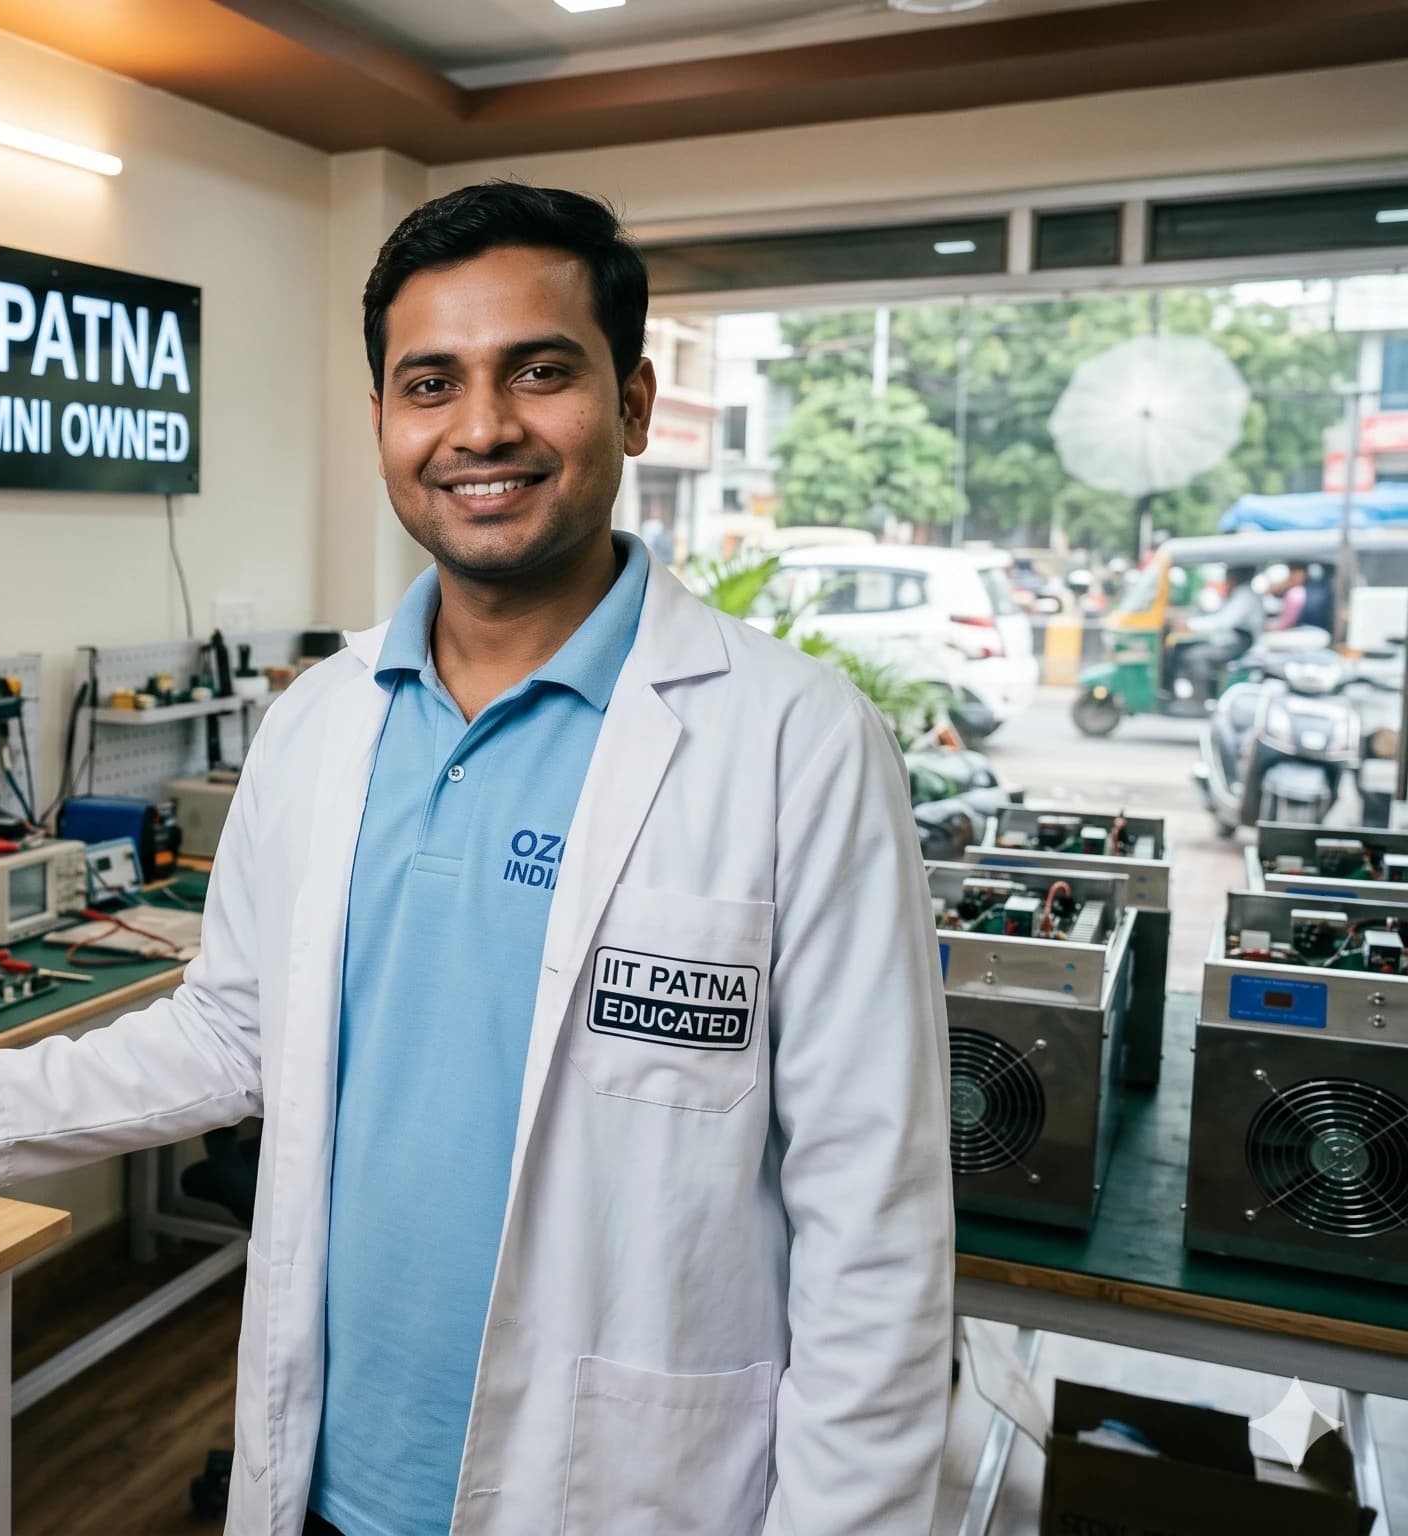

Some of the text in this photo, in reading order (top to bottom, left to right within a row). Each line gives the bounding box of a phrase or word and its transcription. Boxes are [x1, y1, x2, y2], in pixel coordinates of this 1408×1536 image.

[61, 402, 190, 462] OWNED
[503, 859, 559, 890] INDI
[602, 957, 747, 1002] IIT PATNA
[601, 997, 740, 1037] EDUCATED
